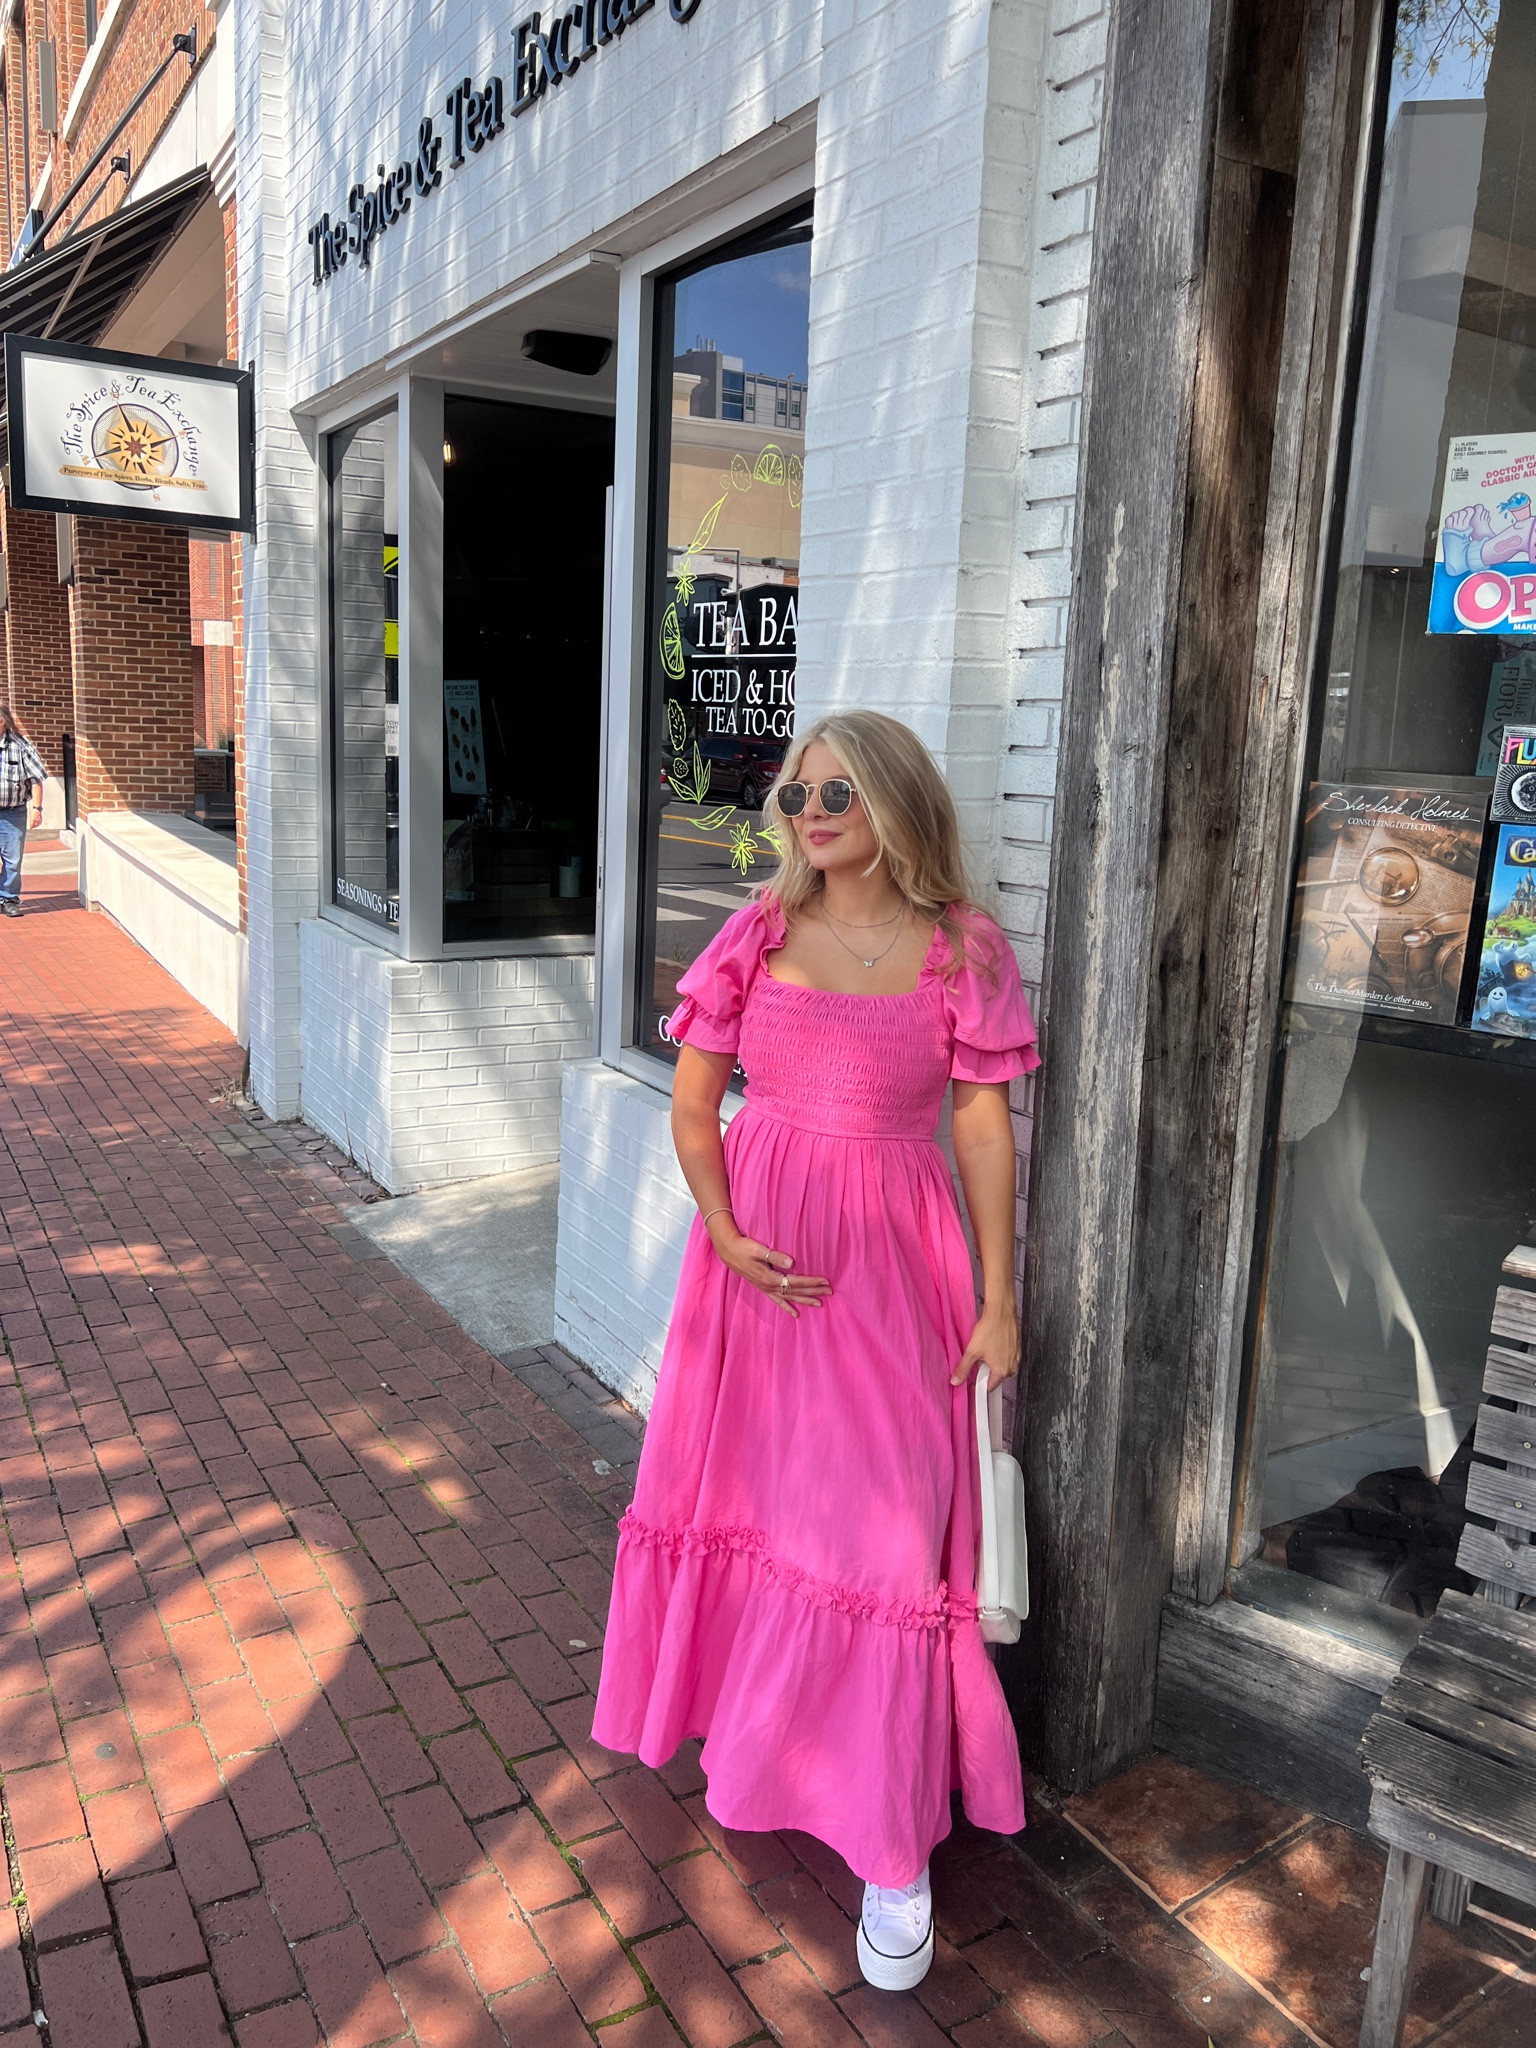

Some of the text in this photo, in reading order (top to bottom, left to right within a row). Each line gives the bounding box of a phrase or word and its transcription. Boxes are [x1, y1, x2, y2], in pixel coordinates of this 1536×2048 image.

[308, 212, 348, 287] The
[348, 163, 412, 270] Spice
[414, 117, 442, 198] &
[446, 76, 505, 169] Tea
[125, 375, 157, 400] Tea
[66, 386, 108, 422] Spice
[60, 423, 84, 455] The
[63, 467, 93, 477] Purveyors
[100, 471, 113, 479] Fine
[1486, 464, 1524, 479] DOCTOR
[1514, 454, 1535, 464] WITH
[1480, 473, 1520, 488] CLASSIC
[693, 599, 750, 647] TEA
[691, 668, 742, 703] ICED
[745, 669, 764, 705] &
[705, 706, 738, 734] TEA
[1321, 792, 1480, 822] Sherlock Holmes
[1347, 817, 1437, 832] CONSULTING DETECTIVE
[336, 877, 383, 914] SEASONINGS
[1314, 982, 1327, 992] The
[1328, 984, 1355, 996] Thames
[1355, 988, 1384, 1001] Murders
[1384, 994, 1394, 1002] &
[1394, 994, 1412, 1004] other
[1412, 999, 1429, 1007] cases
